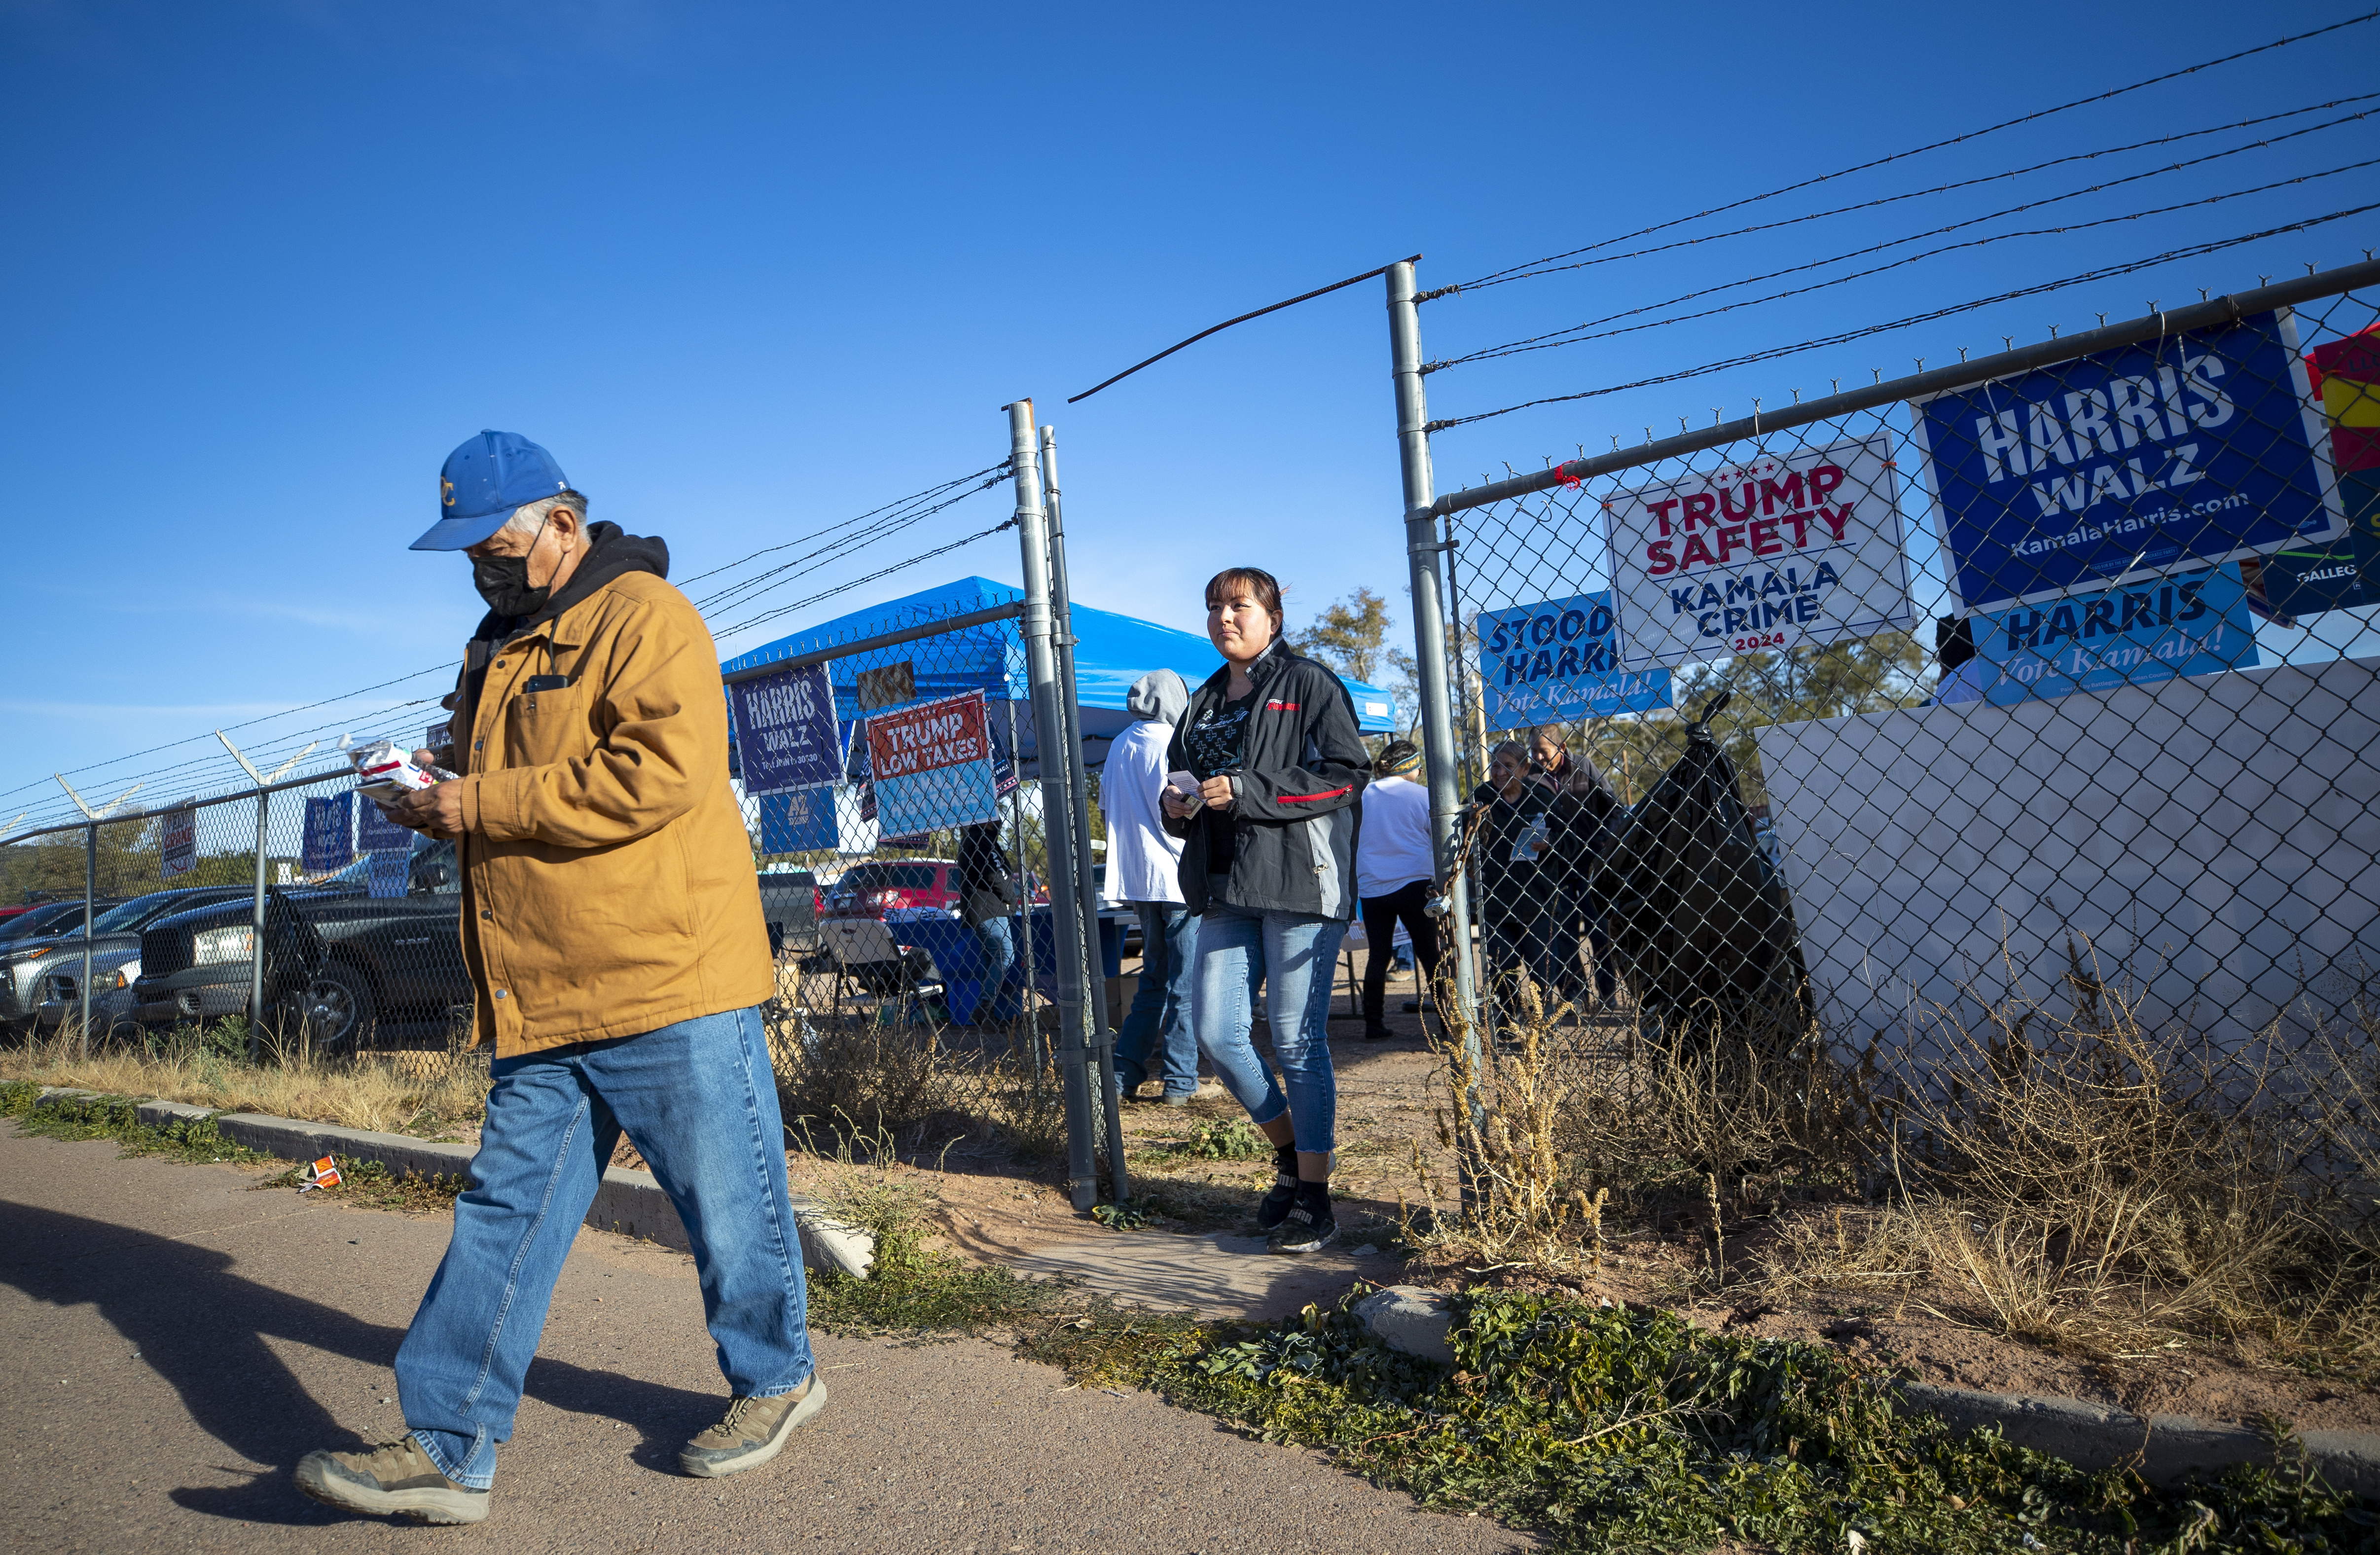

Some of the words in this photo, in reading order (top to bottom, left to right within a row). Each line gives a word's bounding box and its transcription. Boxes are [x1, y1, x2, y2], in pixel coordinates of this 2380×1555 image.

[1976, 355, 2234, 483] HARRIS
[1647, 465, 1844, 537] TRUMP
[2031, 443, 2205, 517] WALZ
[1647, 502, 1855, 576] SAFETY
[2011, 493, 2249, 558] KamalaHarris.com
[2139, 552, 2163, 560] EMOCRATIC
[2296, 564, 2357, 583] GALLEG
[1671, 561, 1841, 615] KAMALA
[1490, 605, 1614, 653] STOOD
[1697, 594, 1821, 638] CRIME
[2008, 580, 2206, 651] HARRIS
[1504, 639, 1618, 686] HARRI
[1735, 632, 1785, 651] 2024
[1997, 655, 2061, 686] Vote
[2069, 624, 2224, 675] Kamala!
[746, 680, 815, 730] HARRIS
[1496, 690, 1539, 715] Vote
[1545, 673, 1652, 708] Kamala!
[763, 725, 809, 752] WALZ
[887, 713, 963, 752] TRUMP
[762, 761, 775, 770] Text
[776, 759, 789, 768] JOIN
[797, 753, 818, 764] 30330
[880, 750, 917, 776] LOW
[923, 737, 978, 767] TAXES
[789, 795, 809, 816] AZ
[891, 795, 927, 818] HIGH
[930, 787, 979, 810] TAXES
[901, 771, 965, 798] KAMAA
[788, 815, 809, 826] DEMS
[1288, 1208, 1313, 1225] UMA
